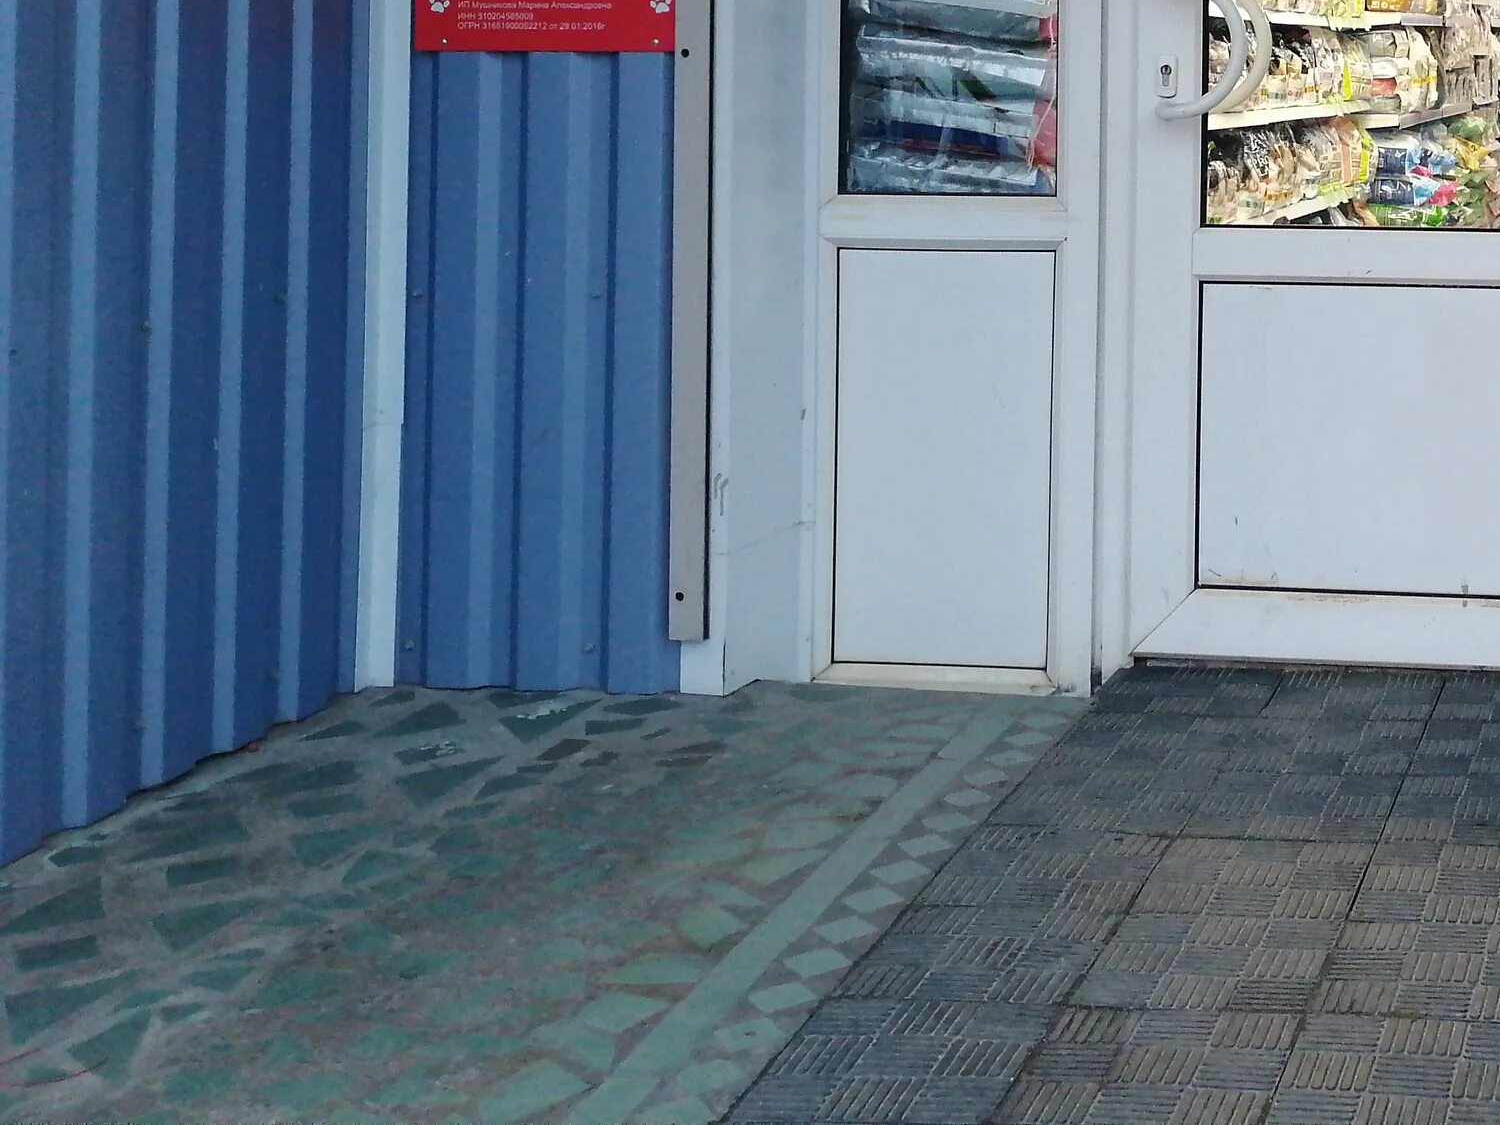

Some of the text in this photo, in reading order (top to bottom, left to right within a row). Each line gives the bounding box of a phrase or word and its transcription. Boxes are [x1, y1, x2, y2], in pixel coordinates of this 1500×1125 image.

[458, 1, 470, 9] ИП
[518, 1, 549, 11] Марина
[458, 12, 476, 20] ИНН
[458, 22, 480, 30] ОГРН
